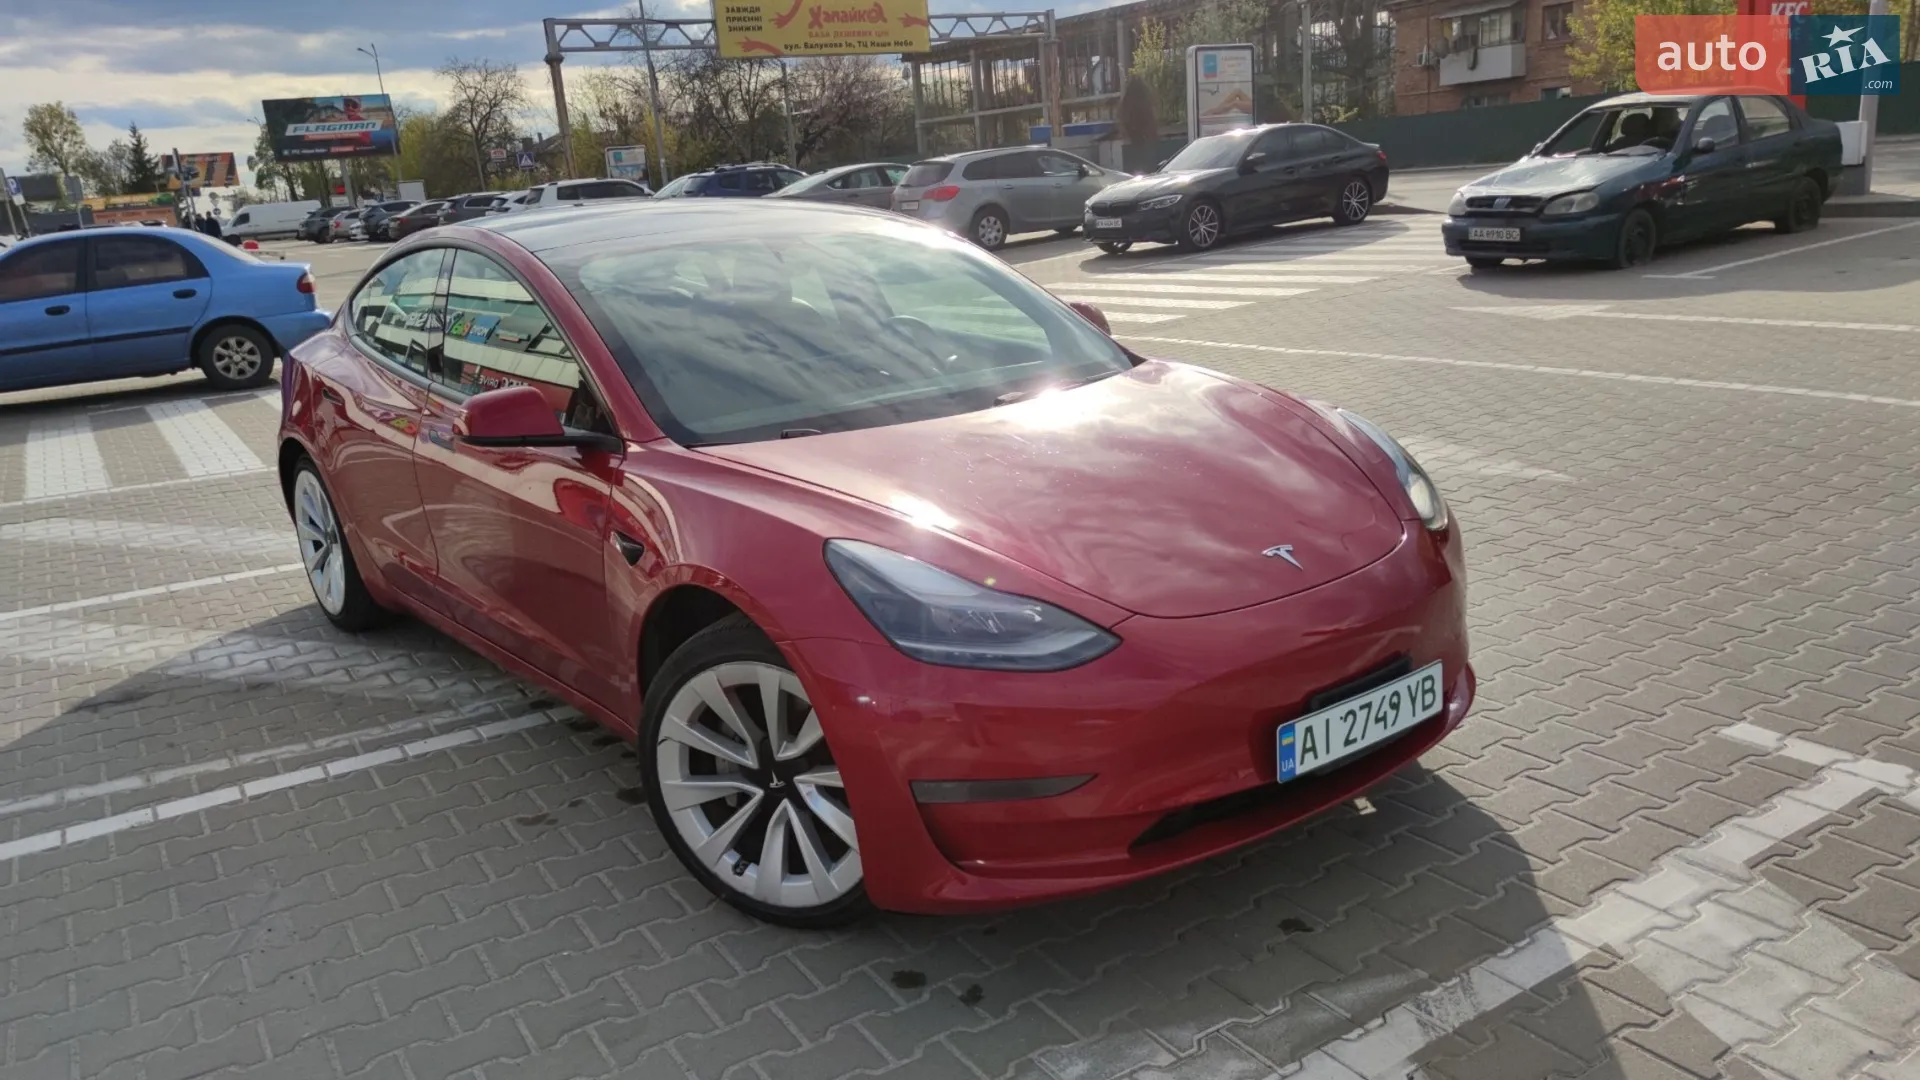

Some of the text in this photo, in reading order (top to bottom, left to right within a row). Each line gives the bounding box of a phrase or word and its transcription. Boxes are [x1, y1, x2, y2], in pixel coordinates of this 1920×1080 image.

[725, 6, 761, 14] ЗАВЖДИ
[894, 39, 914, 48] Небо
[292, 121, 377, 134] FLAGMAN
[1300, 674, 1436, 767] AI 2749 YB
[1282, 758, 1295, 772] UA
